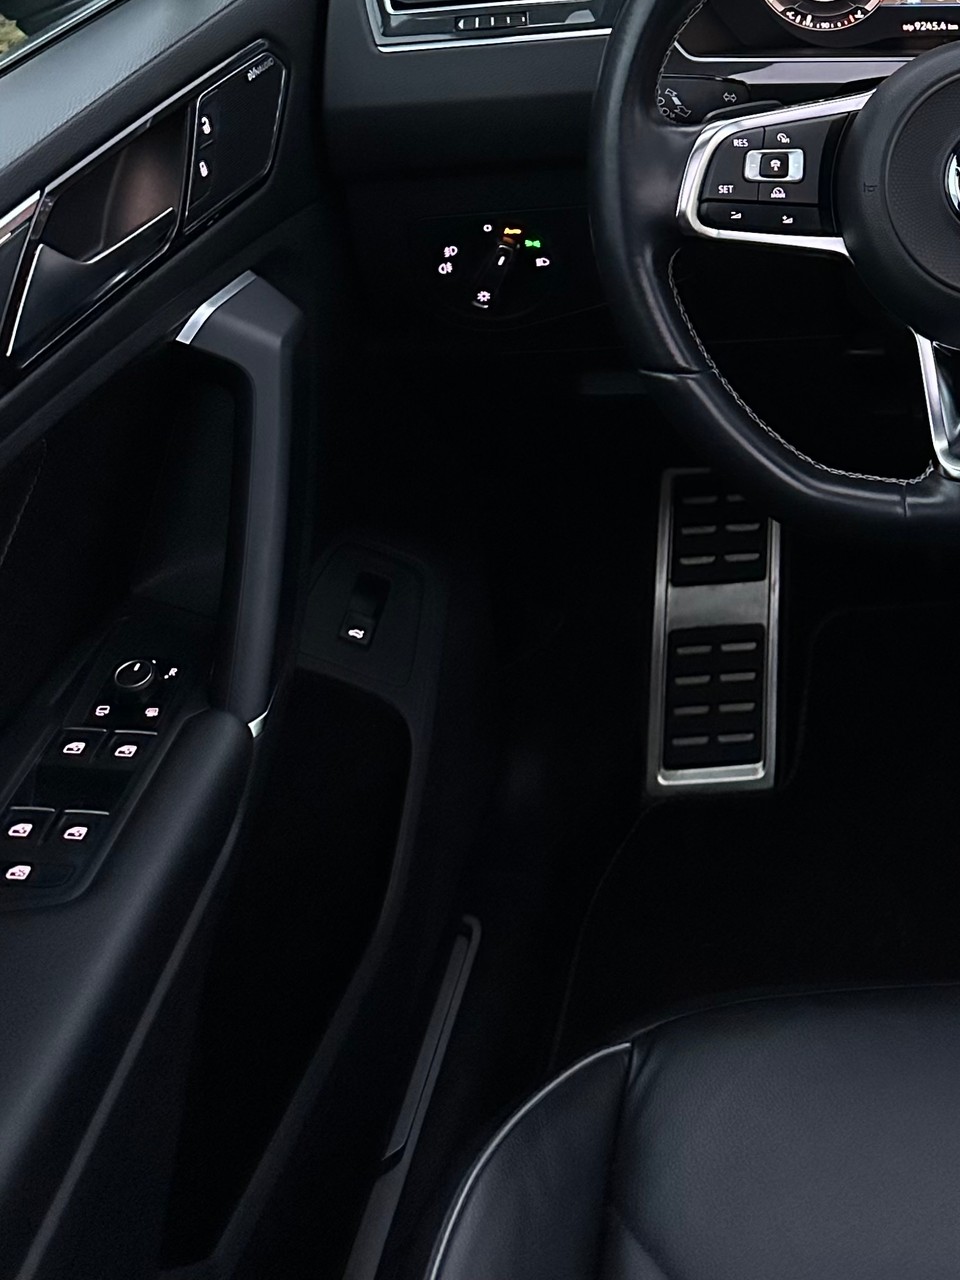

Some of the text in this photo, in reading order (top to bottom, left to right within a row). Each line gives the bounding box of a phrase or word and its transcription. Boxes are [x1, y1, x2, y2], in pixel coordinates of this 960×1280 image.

[914, 21, 947, 31] 9245.4
[733, 138, 749, 147] RES
[718, 185, 734, 194] SET
[169, 667, 178, 676] R
